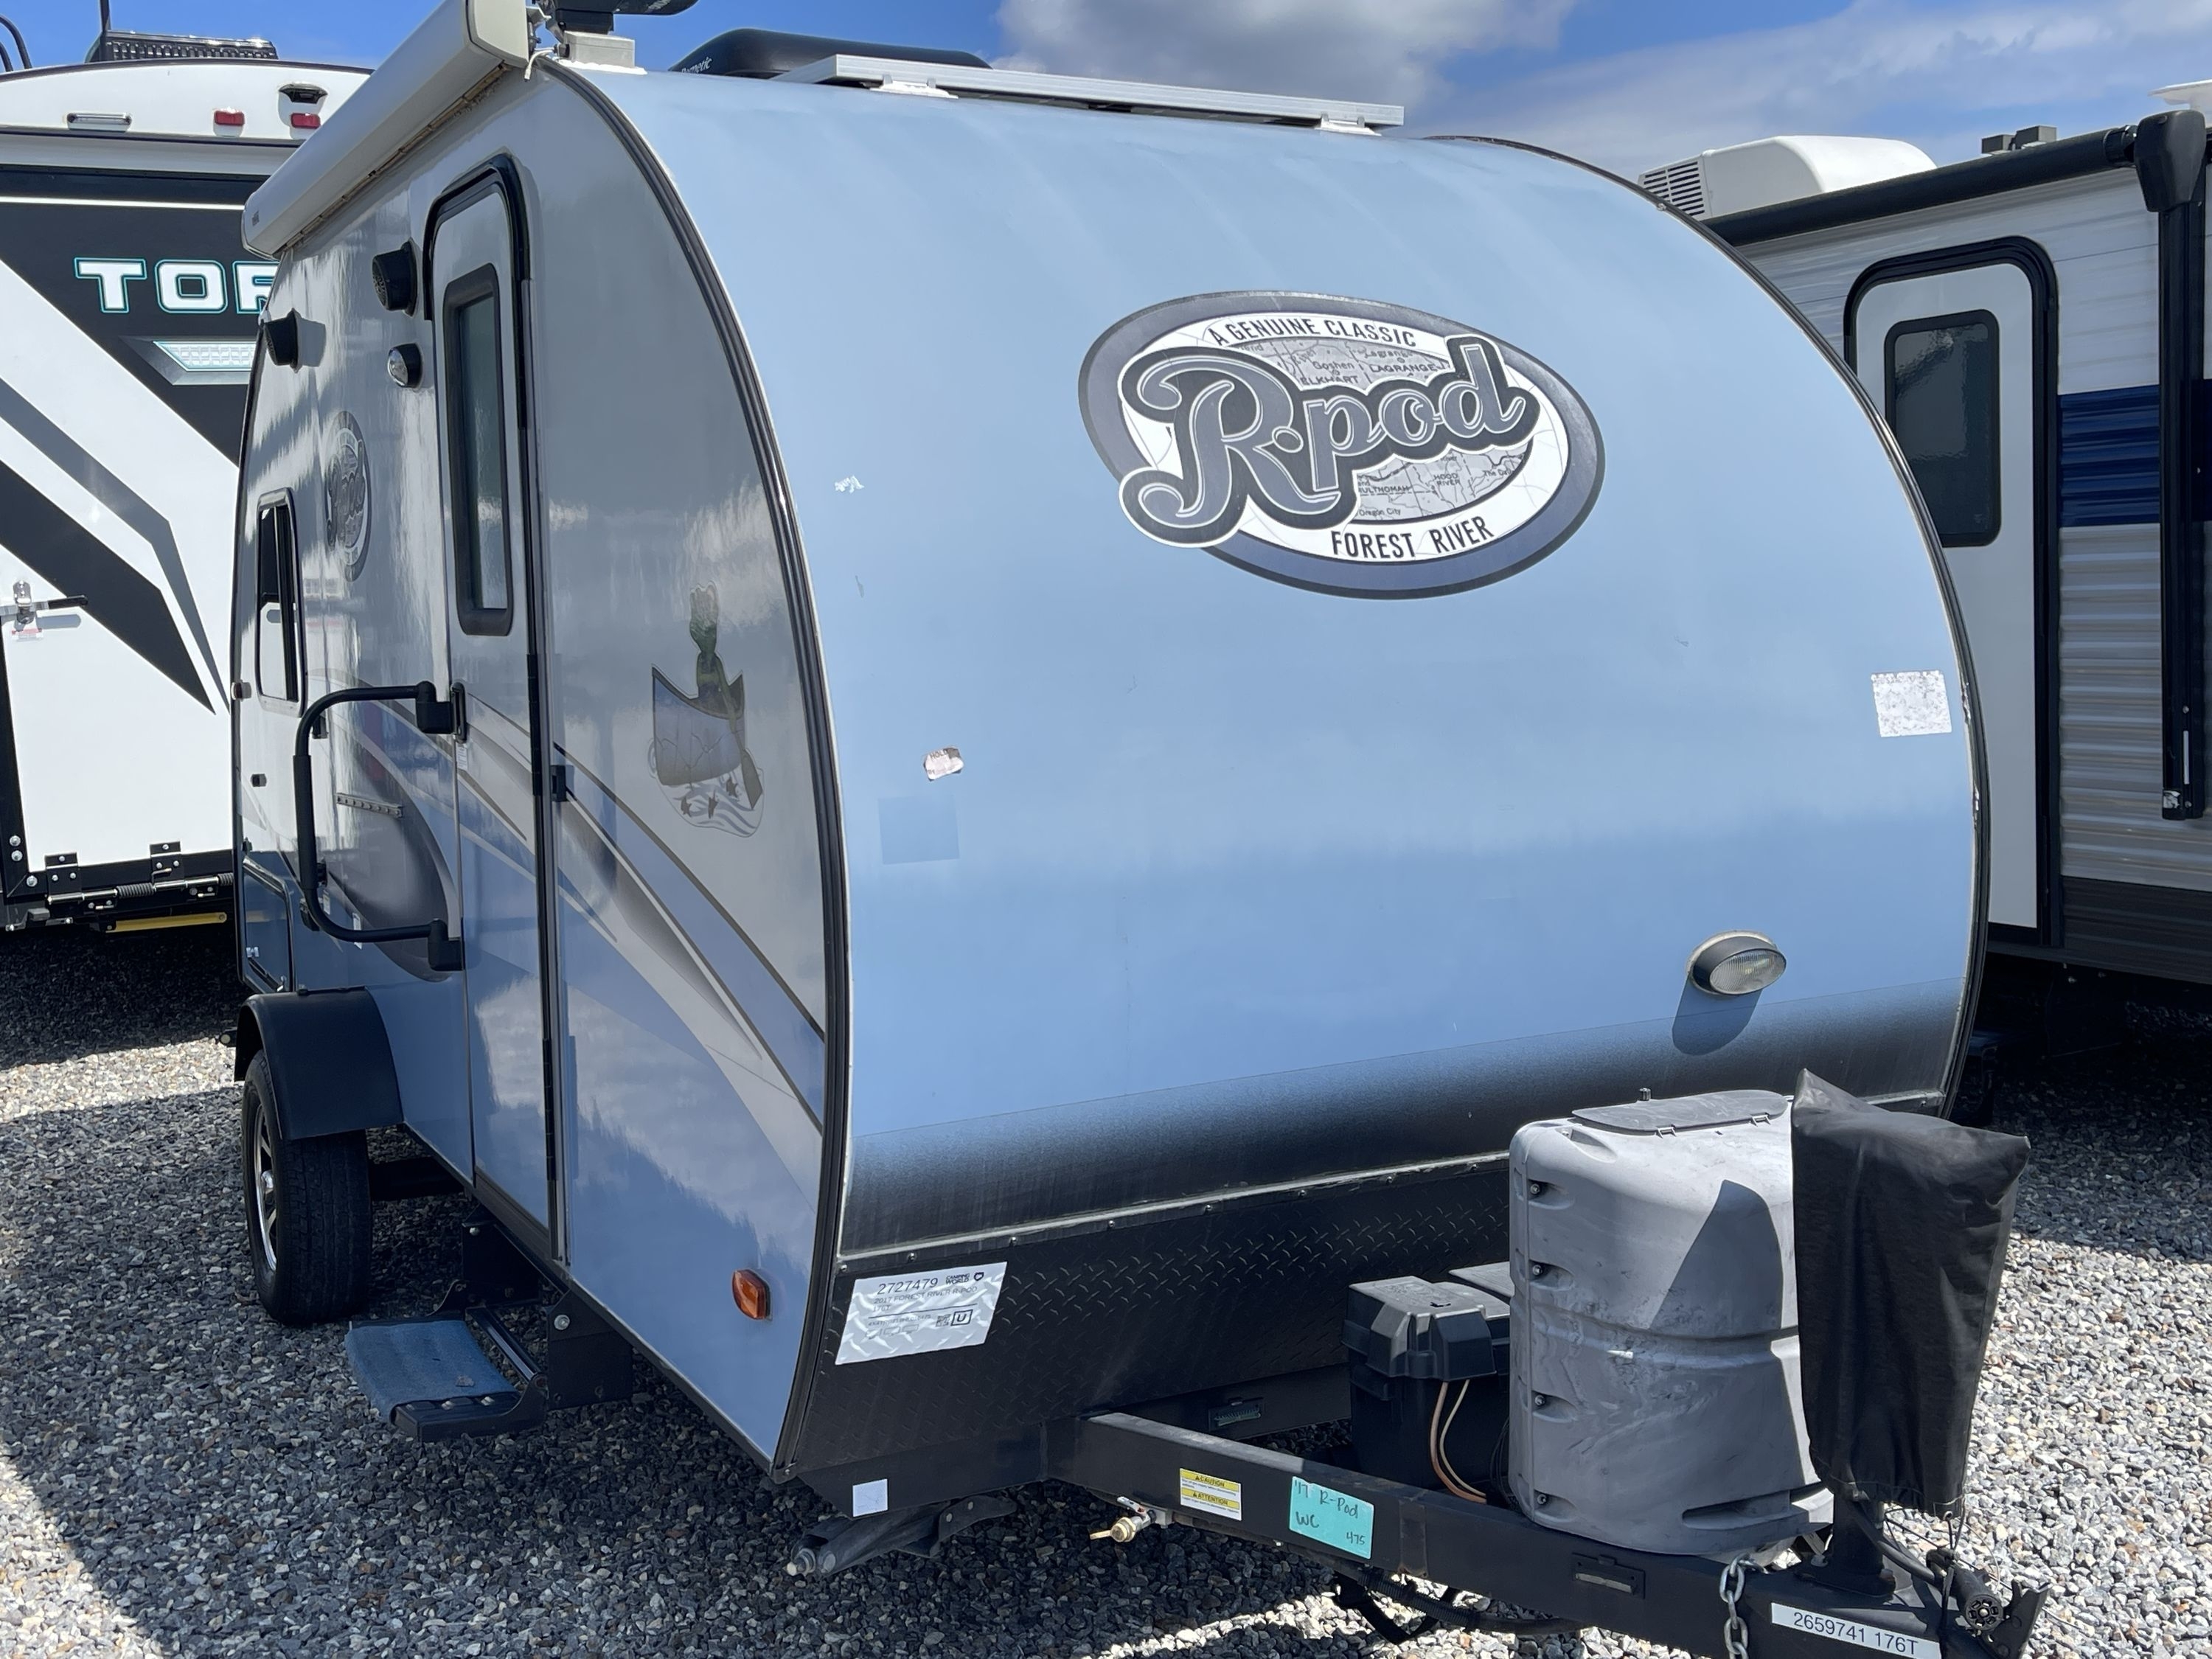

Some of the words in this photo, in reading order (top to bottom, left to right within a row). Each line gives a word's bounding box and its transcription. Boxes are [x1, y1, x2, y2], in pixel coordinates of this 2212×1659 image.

[1208, 327, 1230, 347] A
[1225, 318, 1321, 341] GENUINE
[1324, 319, 1416, 347] CLASSIC
[1368, 363, 1439, 373] LAGRANGE
[1299, 375, 1359, 386] ELKHART
[1433, 472, 1459, 481] HOOD
[1330, 529, 1416, 560] FOREST
[1428, 515, 1495, 554] RIVER
[877, 1278, 939, 1295] 2727479
[893, 1292, 925, 1301] FOREST
[927, 1289, 950, 1297] RIVER
[1200, 1475, 1225, 1487] CAUTION
[1197, 1492, 1228, 1506] ATTENTION
[1295, 1511, 1320, 1528] WC
[1345, 1531, 1366, 1546] 475
[1792, 1611, 1866, 1644] 2659741
[1874, 1631, 1920, 1655] 176T
